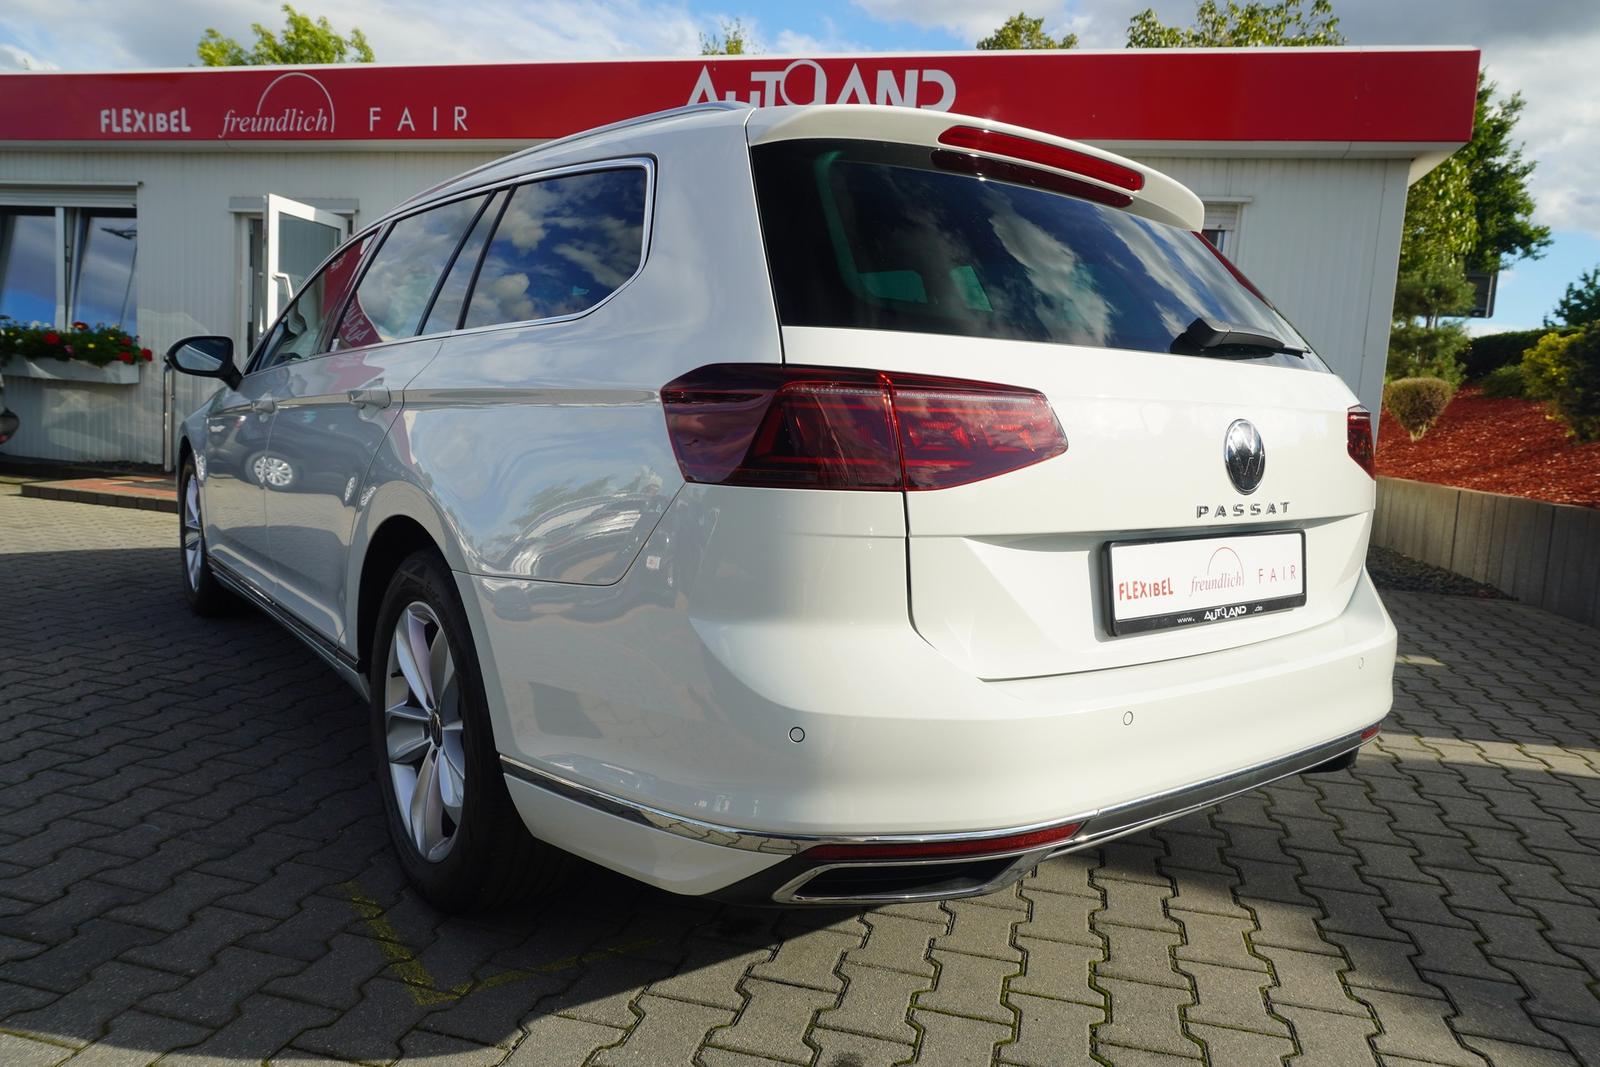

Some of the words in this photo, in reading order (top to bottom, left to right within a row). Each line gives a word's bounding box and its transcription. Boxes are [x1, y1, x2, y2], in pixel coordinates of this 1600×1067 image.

[686, 59, 957, 112] ATOAND
[100, 107, 191, 134] FLEXIBEL
[218, 108, 328, 138] freundlich
[369, 106, 469, 132] FAIR
[1196, 501, 1290, 519] PASSAT
[1118, 577, 1174, 601] FLEXIBEL
[1188, 570, 1243, 598] freundlich
[1258, 564, 1297, 585] FAIR
[1203, 605, 1247, 621] AUTOLAND
